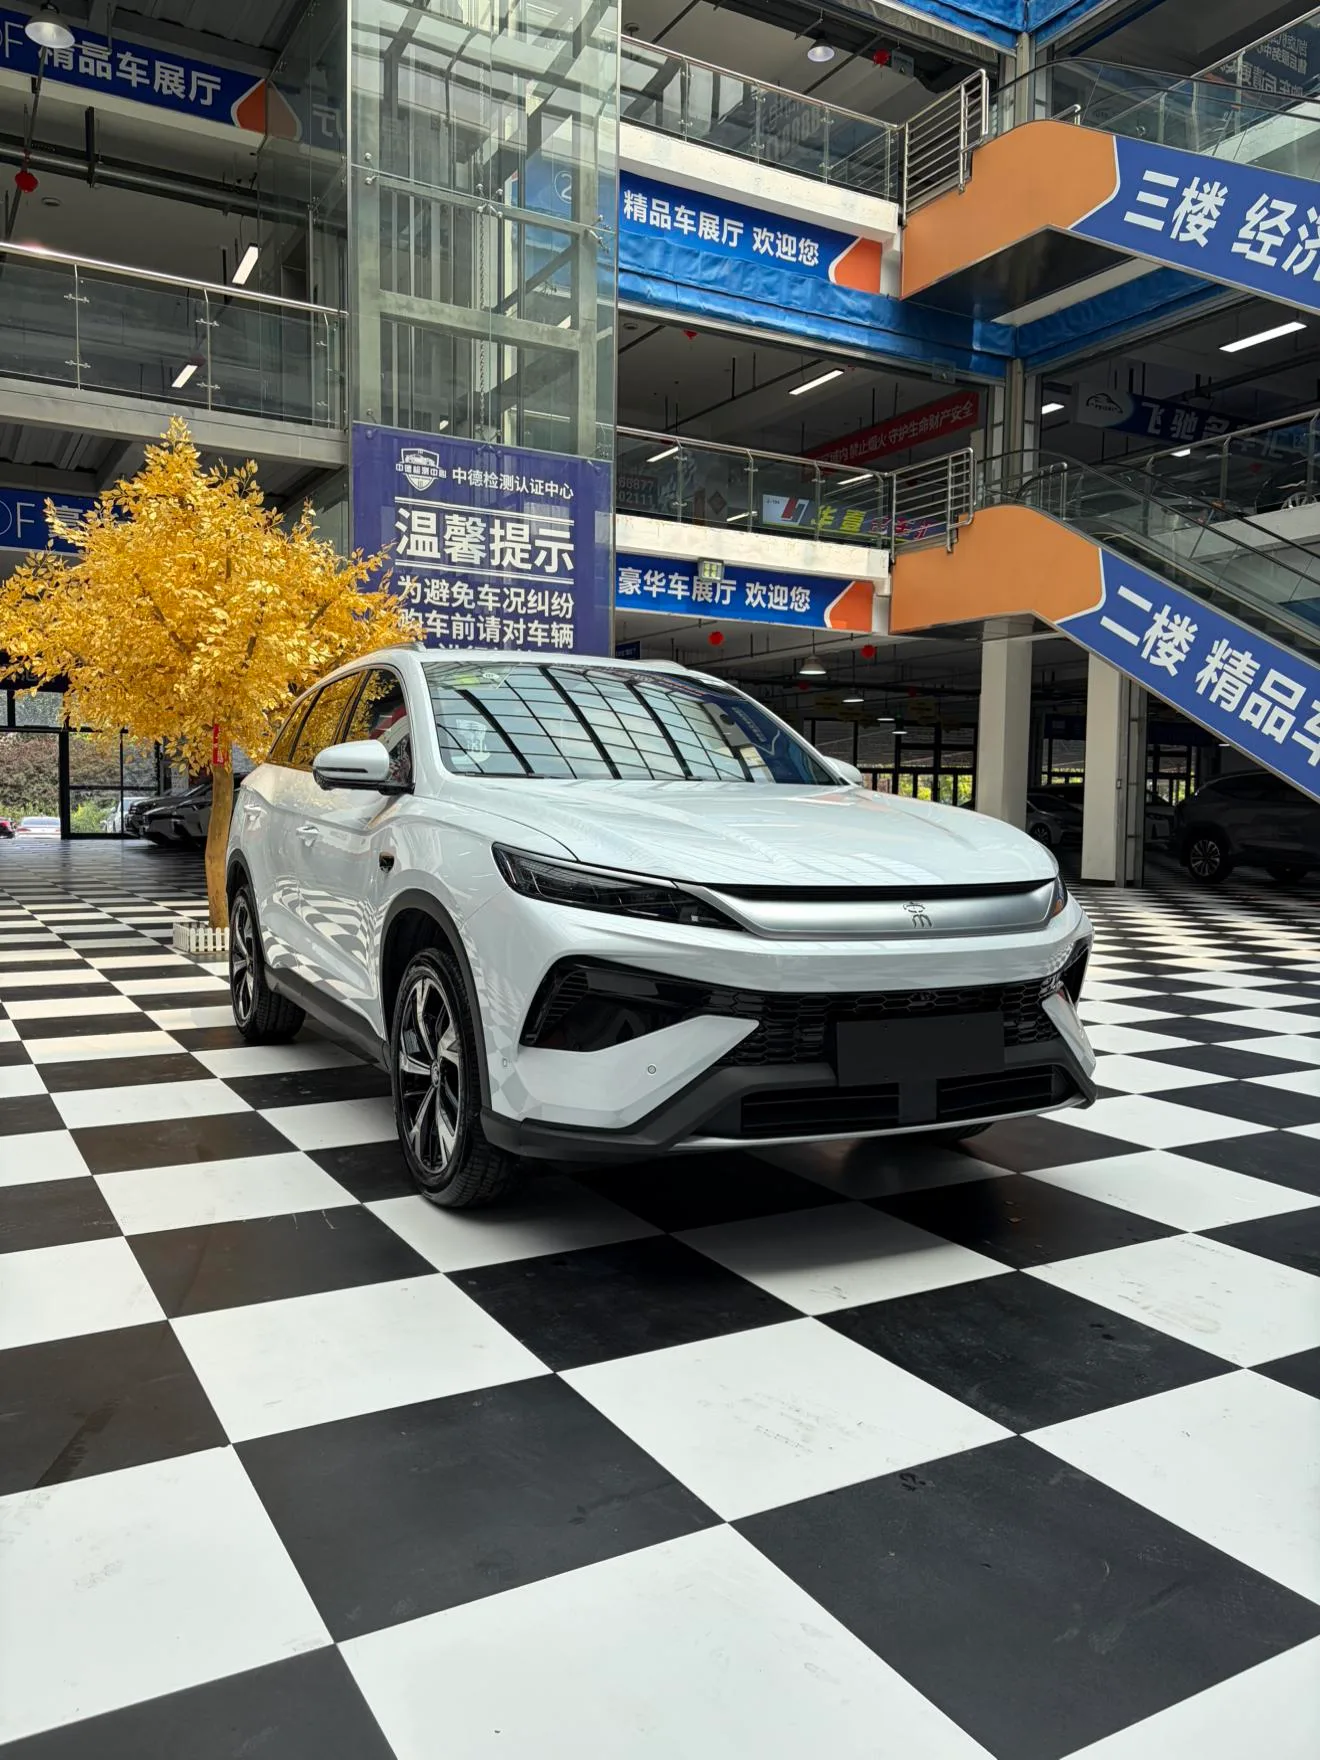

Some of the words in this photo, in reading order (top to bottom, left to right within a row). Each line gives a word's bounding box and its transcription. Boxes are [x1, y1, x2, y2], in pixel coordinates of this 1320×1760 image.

[623, 189, 744, 248] 精品车展厅
[752, 226, 819, 266] 欢迎您
[1123, 169, 1229, 247] 三楼
[452, 467, 574, 499] 中德检测认证中心
[394, 508, 575, 573] 温馨提示
[397, 575, 575, 619] 为避免车况纠纷
[618, 566, 737, 605] 豪华车展厅
[745, 581, 811, 613] 欢迎您
[397, 608, 575, 649] 购车前请对车辆
[1099, 585, 1199, 677] 二楼
